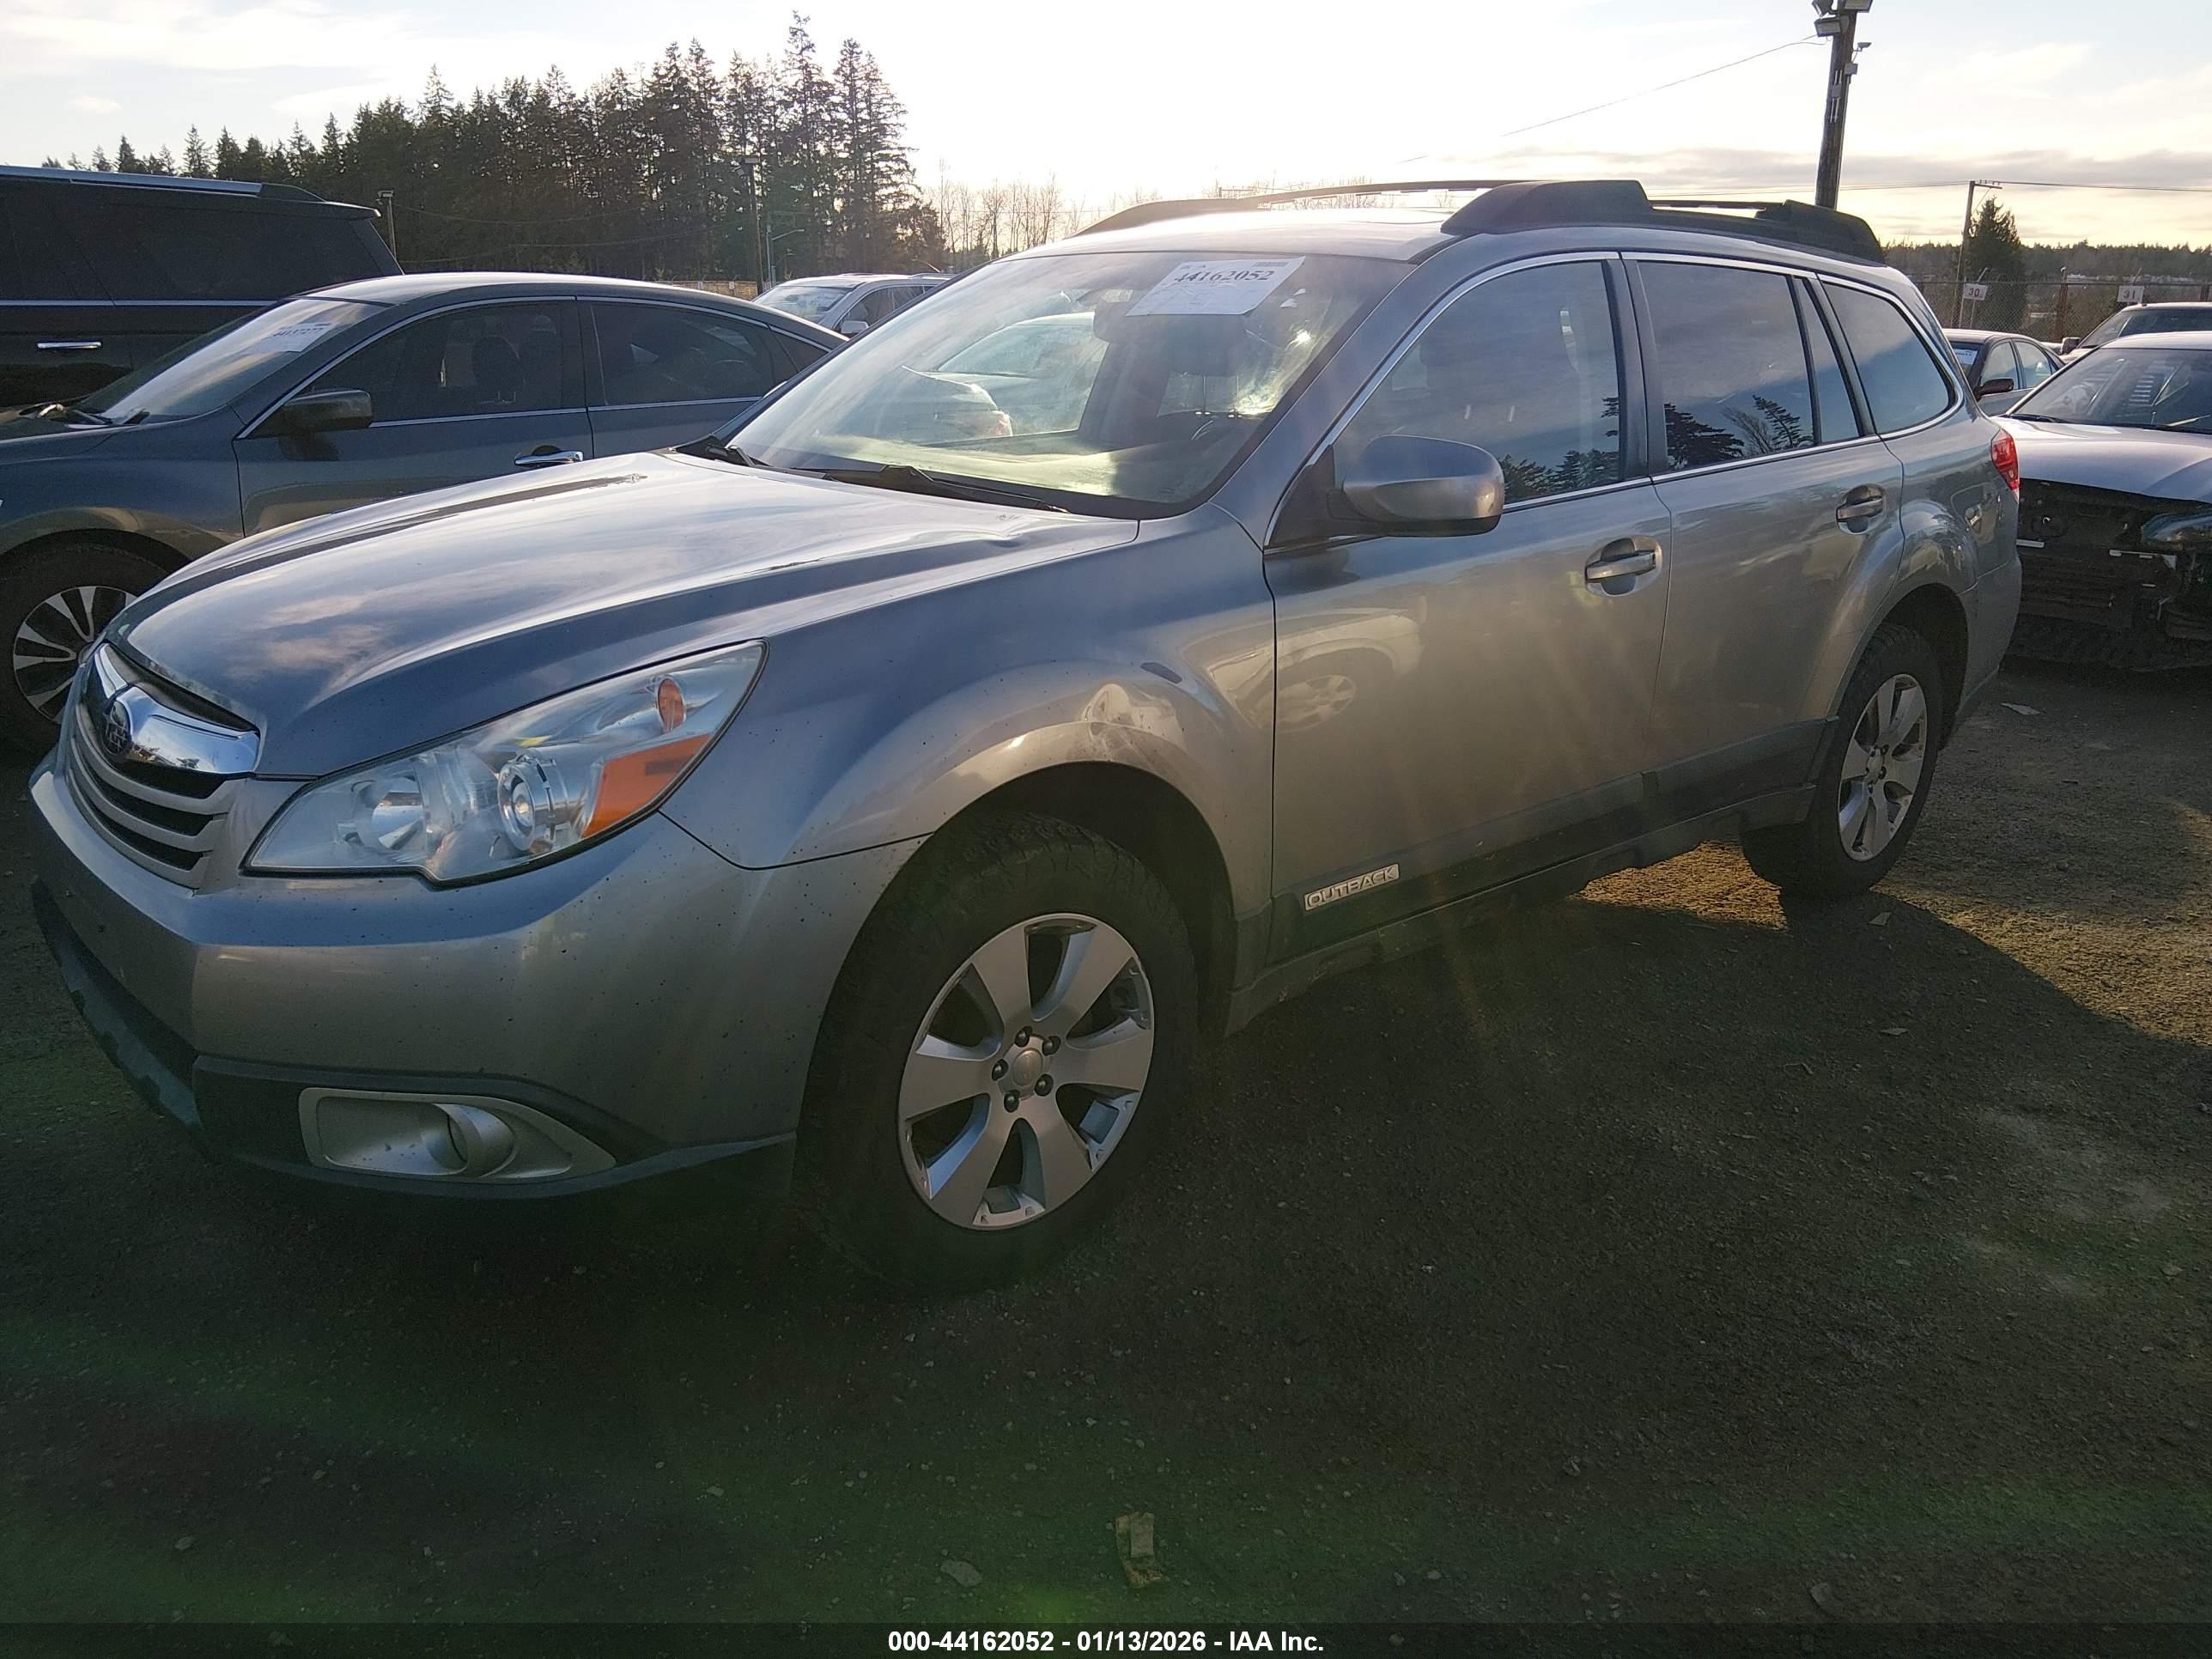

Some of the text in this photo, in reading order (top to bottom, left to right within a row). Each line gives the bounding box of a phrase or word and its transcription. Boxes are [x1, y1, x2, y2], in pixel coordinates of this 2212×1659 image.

[1174, 270, 1275, 283] 44162052
[1968, 288, 1980, 297] 30
[2123, 289, 2136, 300] 31
[1306, 866, 1397, 908] OUTBACK
